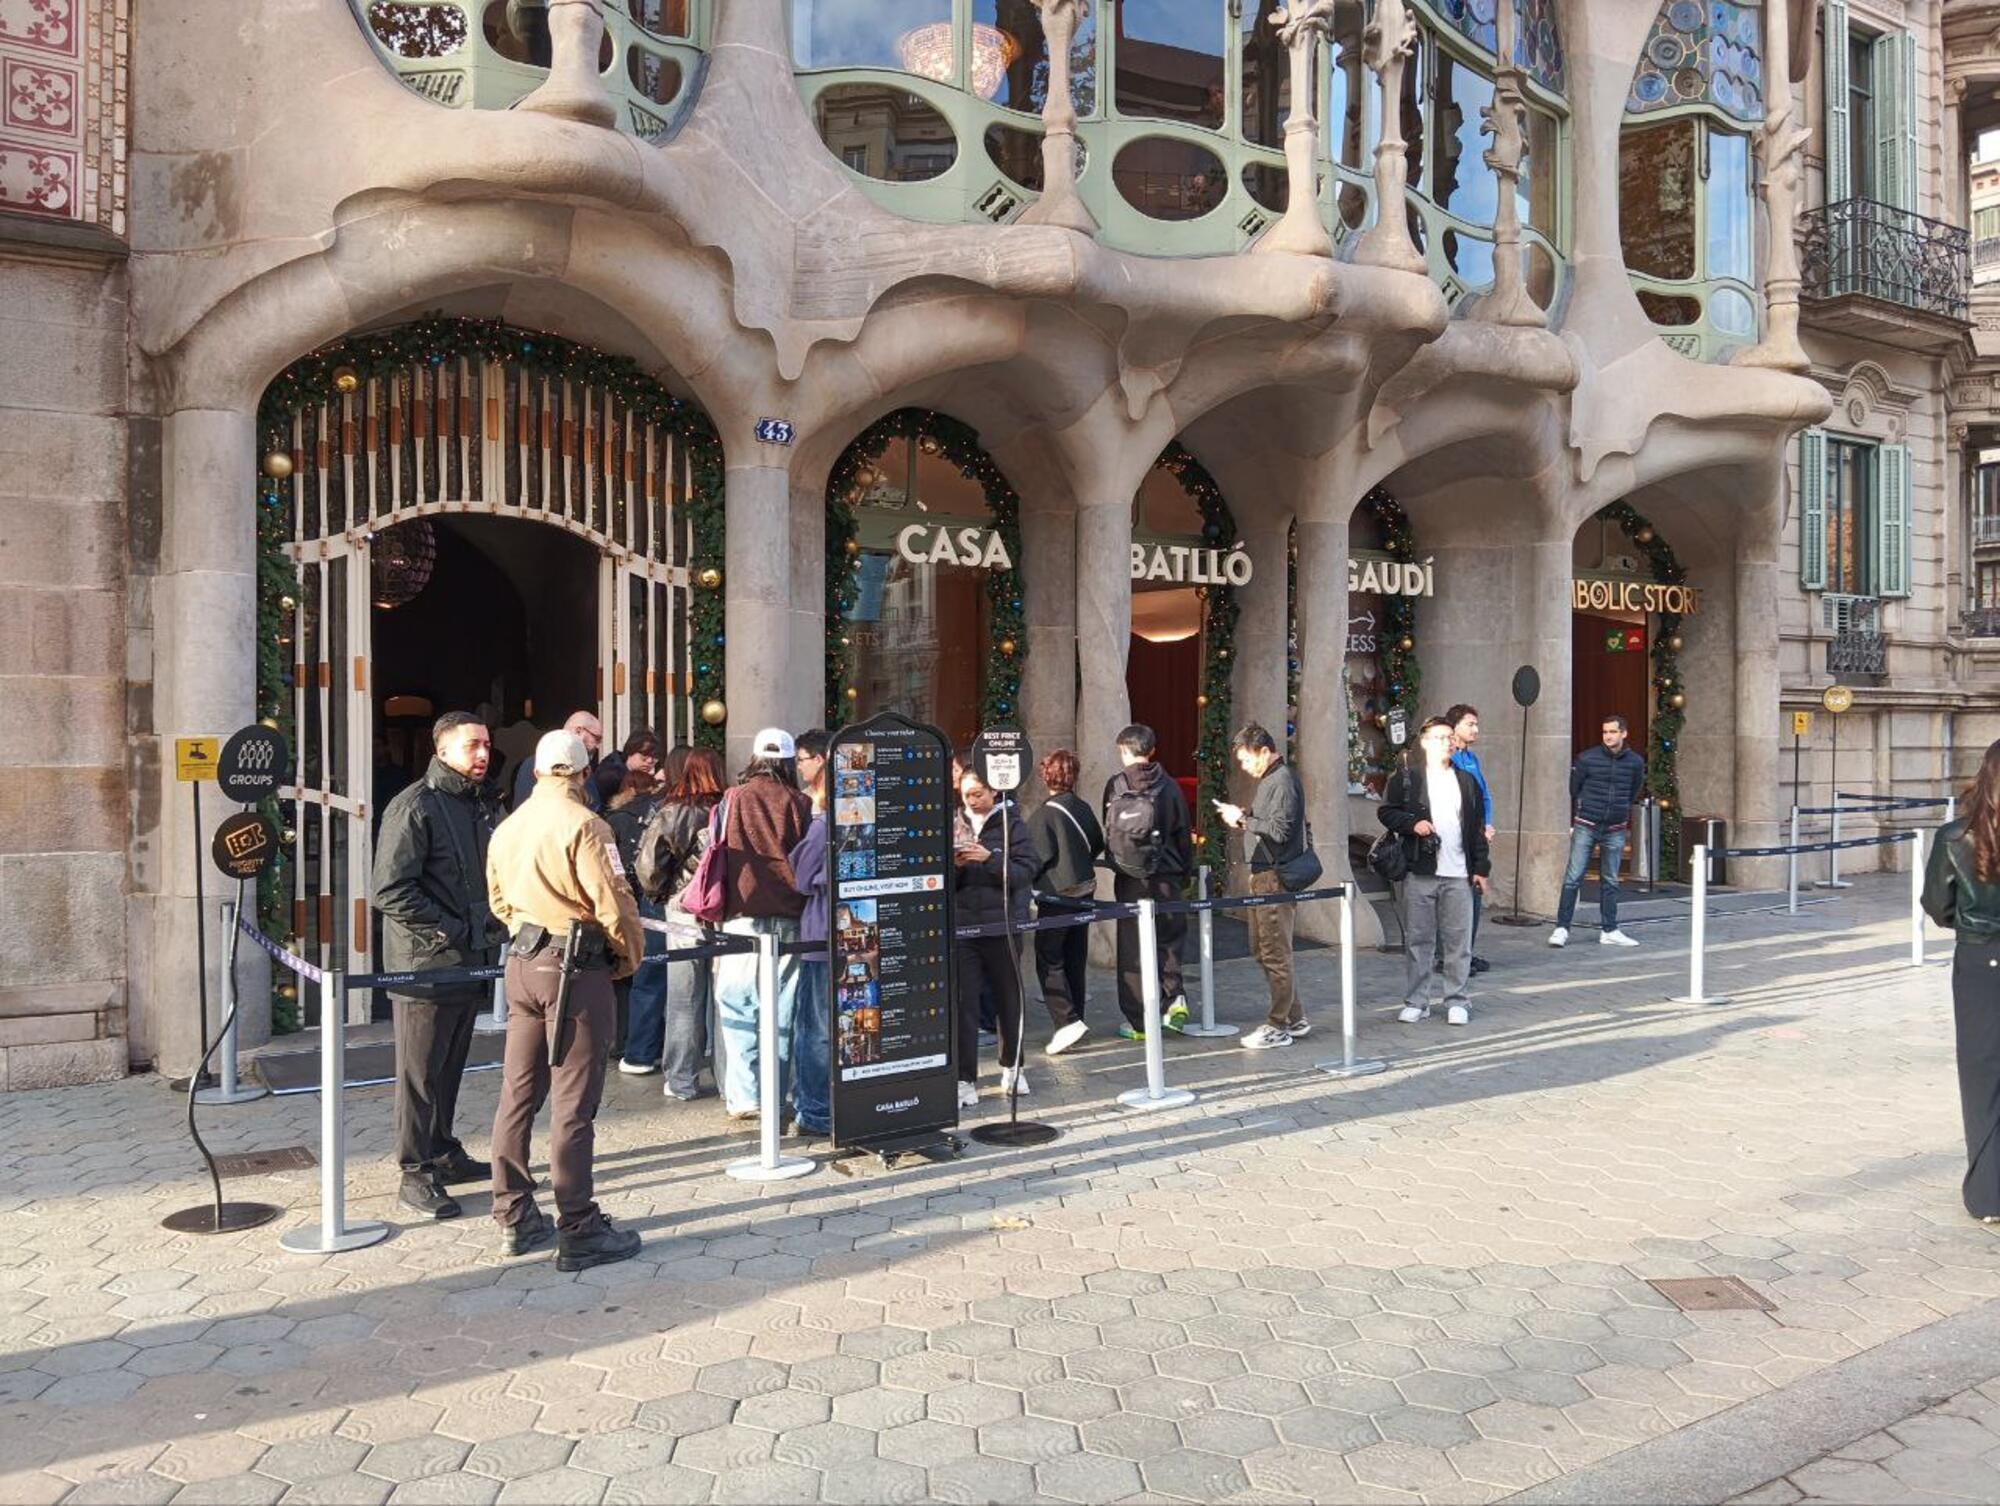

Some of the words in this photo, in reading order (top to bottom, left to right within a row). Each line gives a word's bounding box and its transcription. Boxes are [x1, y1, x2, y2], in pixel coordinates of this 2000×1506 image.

[763, 421, 790, 442] 43
[898, 524, 1012, 569] CASA
[1130, 540, 1253, 586] BATLLÓ
[1347, 556, 1434, 597] GAUDÍ
[983, 732, 1000, 740] BEST
[1001, 732, 1021, 740] PRICE
[229, 774, 274, 785] GROUPS
[875, 1103, 894, 1112] CASA
